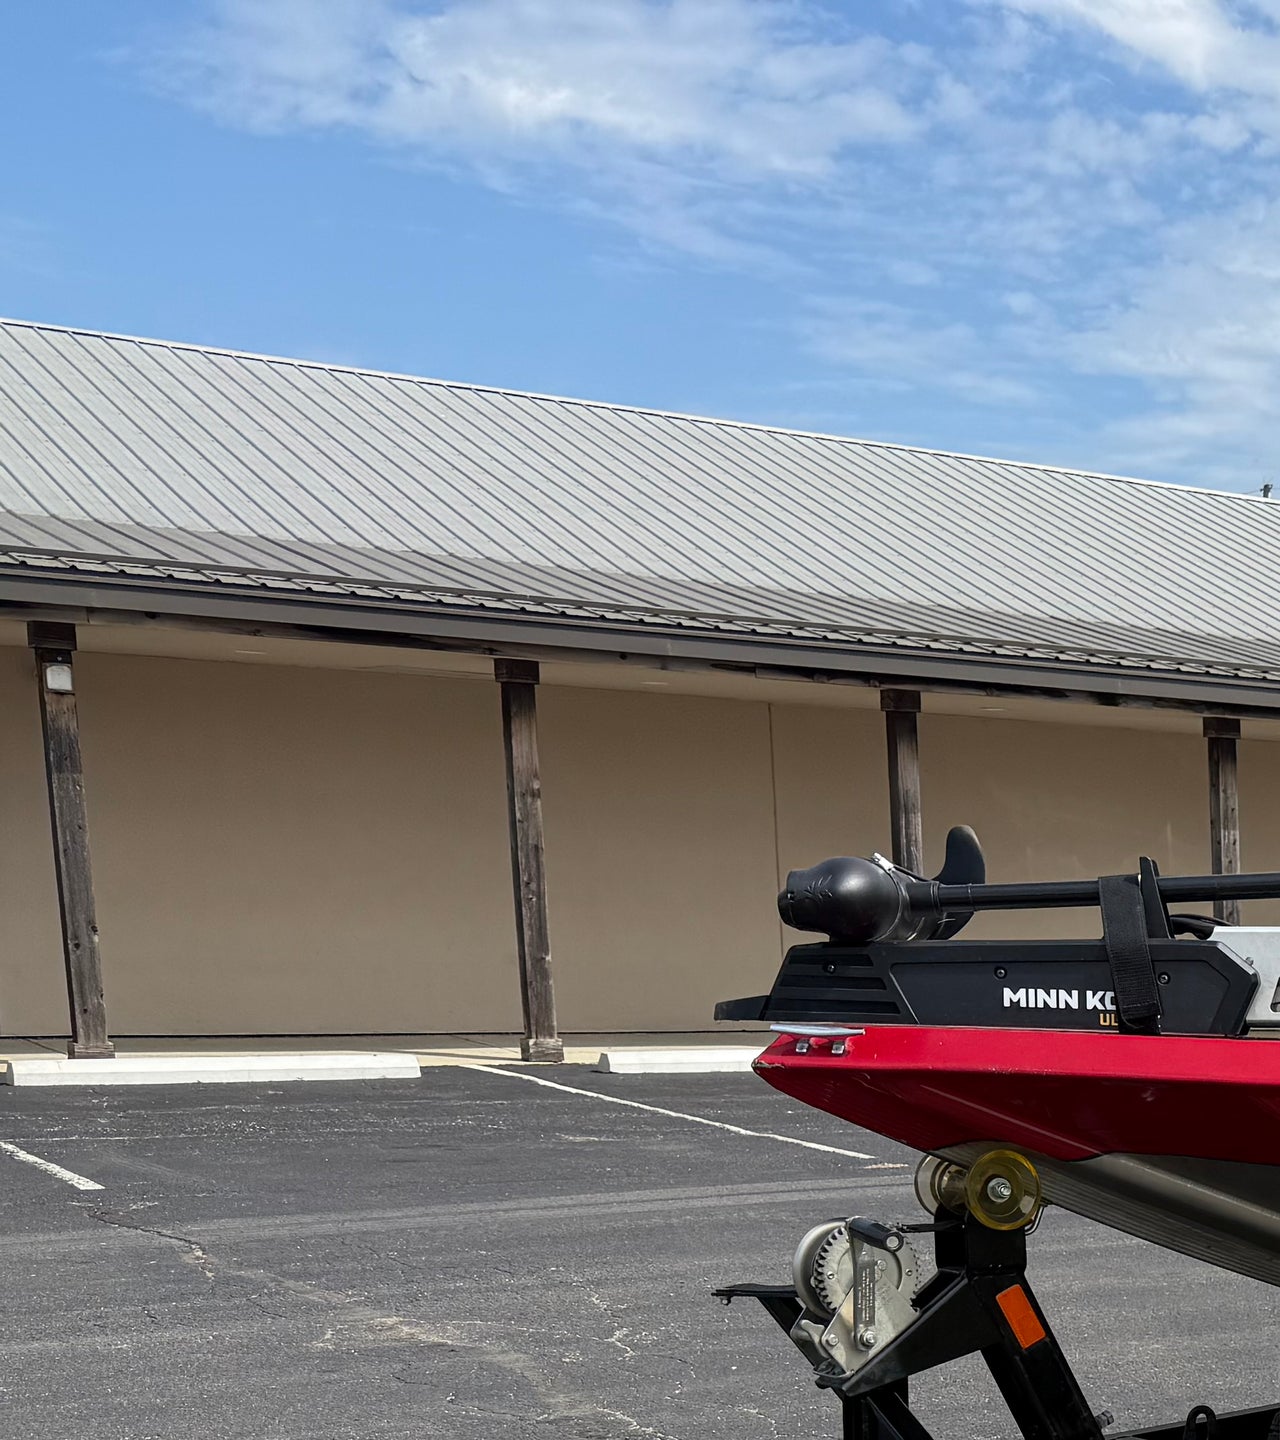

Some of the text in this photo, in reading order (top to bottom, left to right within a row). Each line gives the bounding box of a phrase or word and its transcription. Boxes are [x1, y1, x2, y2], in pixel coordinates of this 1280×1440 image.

[1003, 987, 1118, 1011] MINN KO
[1099, 1013, 1119, 1026] UL
